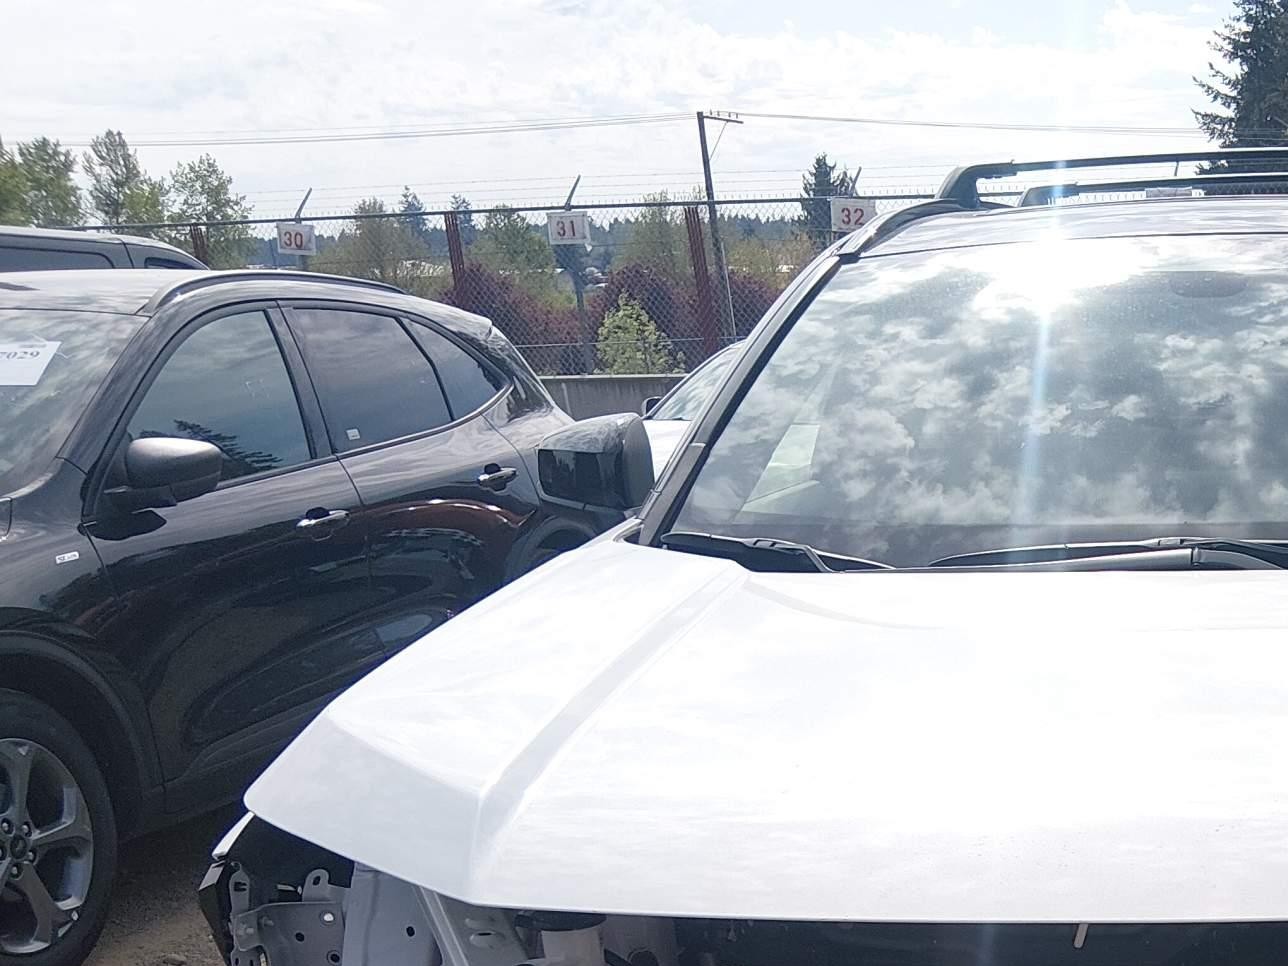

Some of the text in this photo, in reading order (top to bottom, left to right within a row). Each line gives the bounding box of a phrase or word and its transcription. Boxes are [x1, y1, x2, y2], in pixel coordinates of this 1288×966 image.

[841, 207, 865, 226] 32
[556, 220, 576, 237] 31
[283, 231, 303, 249] 30
